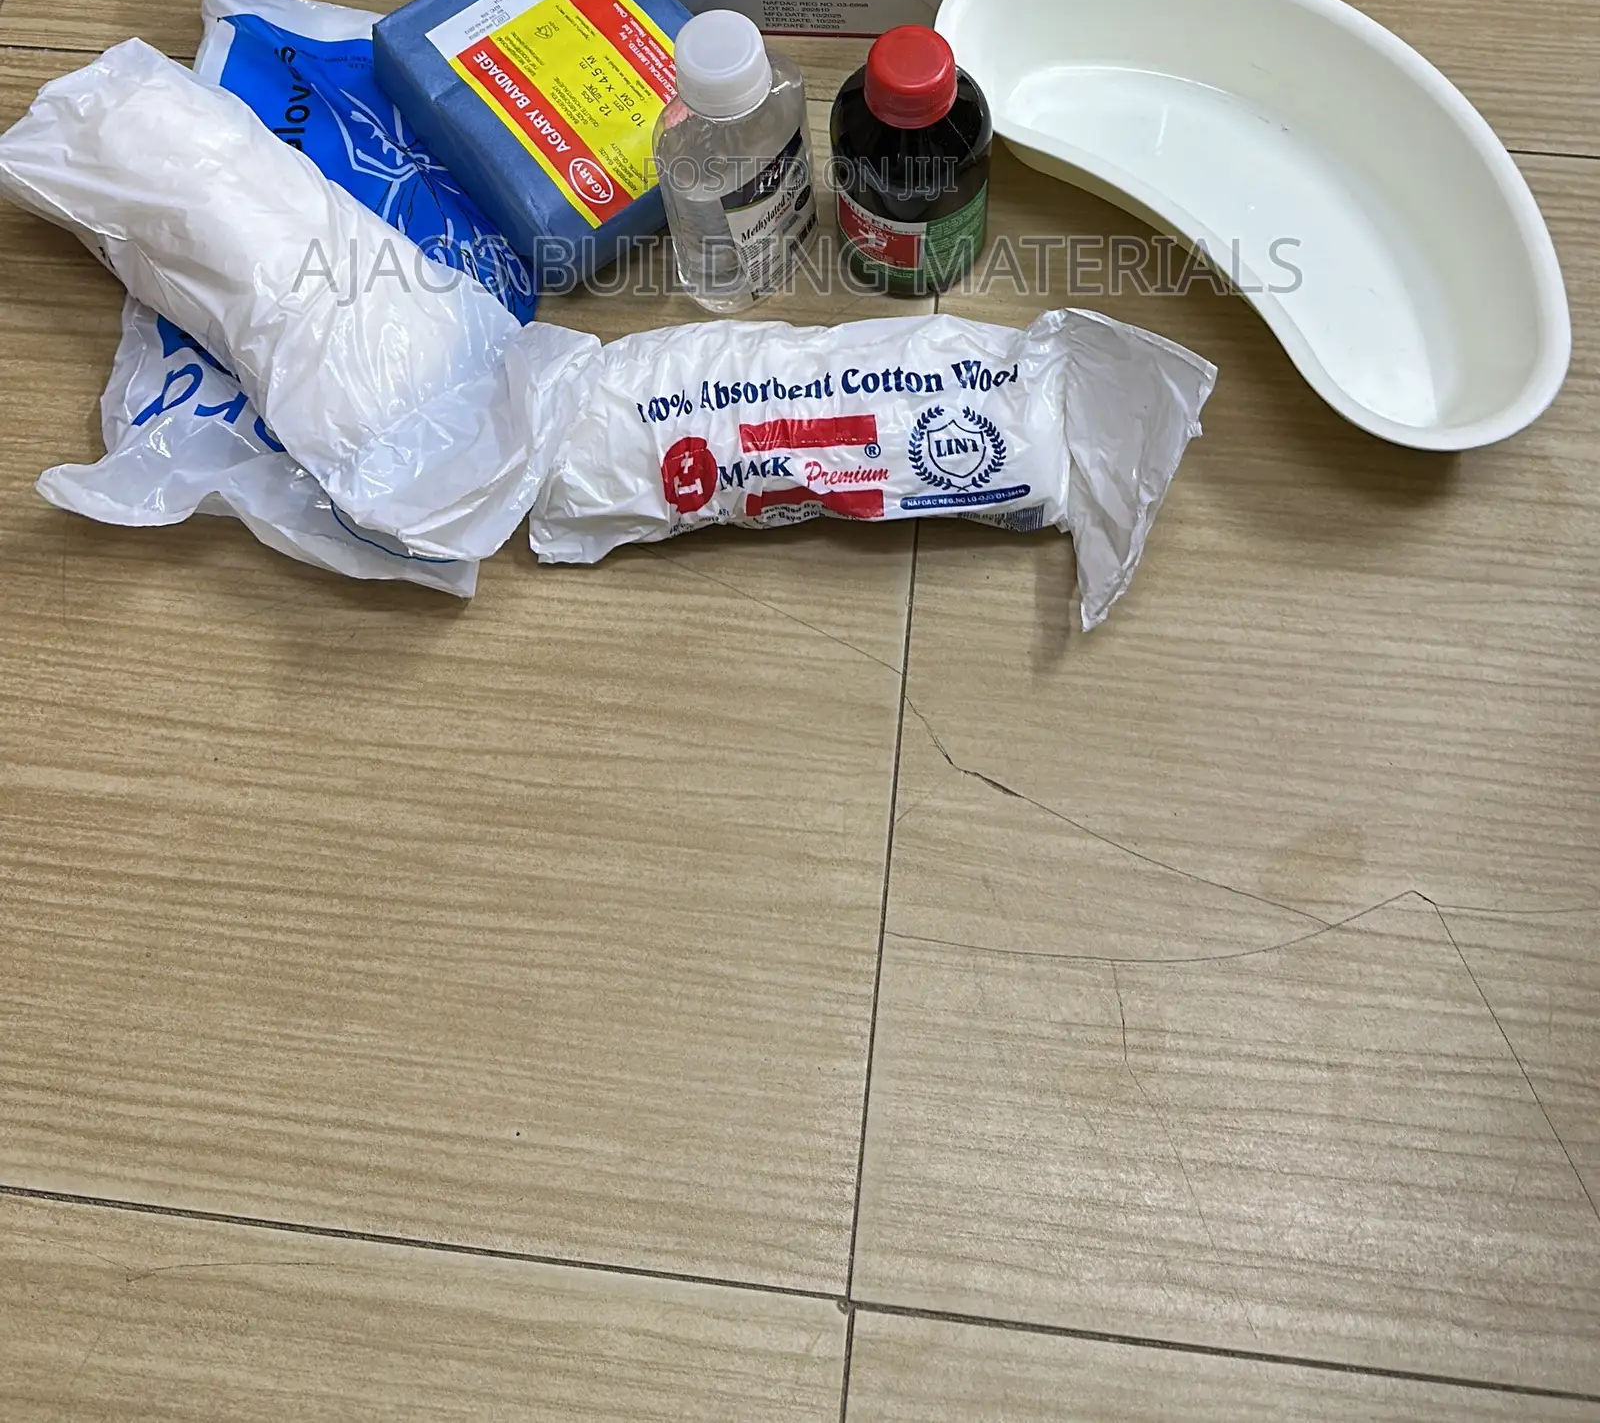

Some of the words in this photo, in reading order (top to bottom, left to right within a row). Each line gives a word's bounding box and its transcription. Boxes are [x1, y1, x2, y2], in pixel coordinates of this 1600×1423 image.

[617, 29, 628, 41] by
[621, 22, 633, 35] Ltd
[577, 60, 588, 70] m
[590, 65, 610, 86] 4.5
[471, 46, 532, 112] BANDAGE
[646, 63, 678, 97] ACEUTICAL
[579, 88, 595, 105] pcs
[612, 99, 625, 112] cm
[597, 101, 613, 118] 12
[629, 110, 646, 128] 10
[523, 104, 573, 157] AGARY
[611, 155, 634, 179] BANDAGE
[571, 159, 611, 202] AGARY
[741, 195, 786, 244] Methylated
[700, 371, 835, 411] Absorbent
[841, 365, 944, 394] Cotton
[934, 437, 980, 458] LINT
[804, 460, 890, 488] Premium
